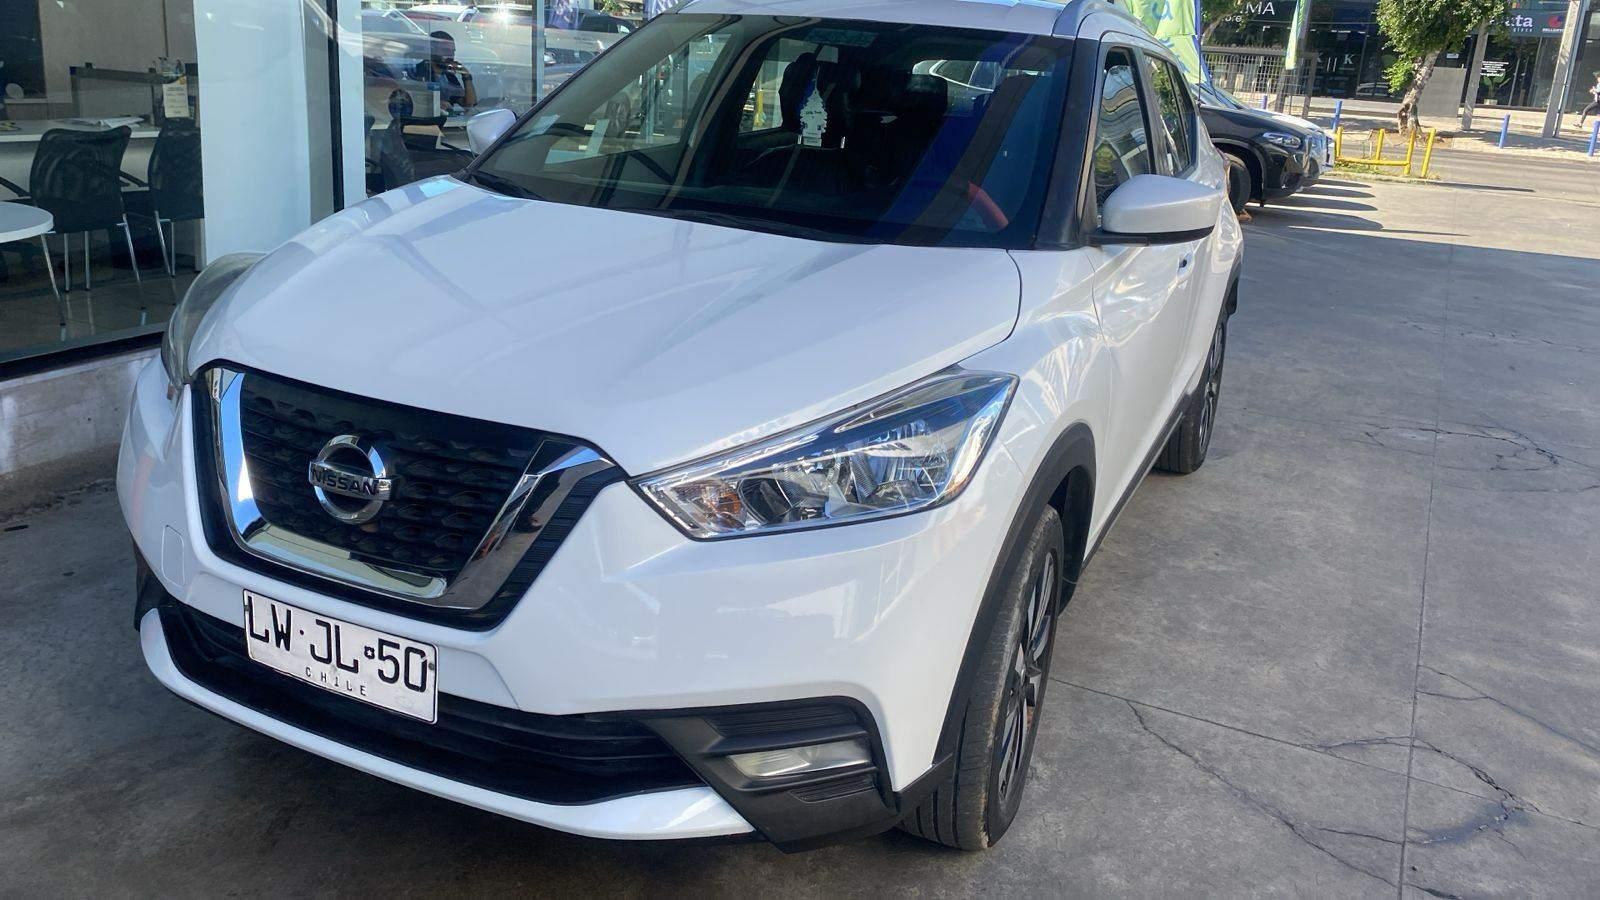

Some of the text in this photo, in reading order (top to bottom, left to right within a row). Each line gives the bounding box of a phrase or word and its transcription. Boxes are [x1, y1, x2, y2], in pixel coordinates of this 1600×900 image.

[1240, 1, 1275, 15] MA
[312, 465, 379, 496] NISSAN
[305, 667, 367, 697] CHILE
